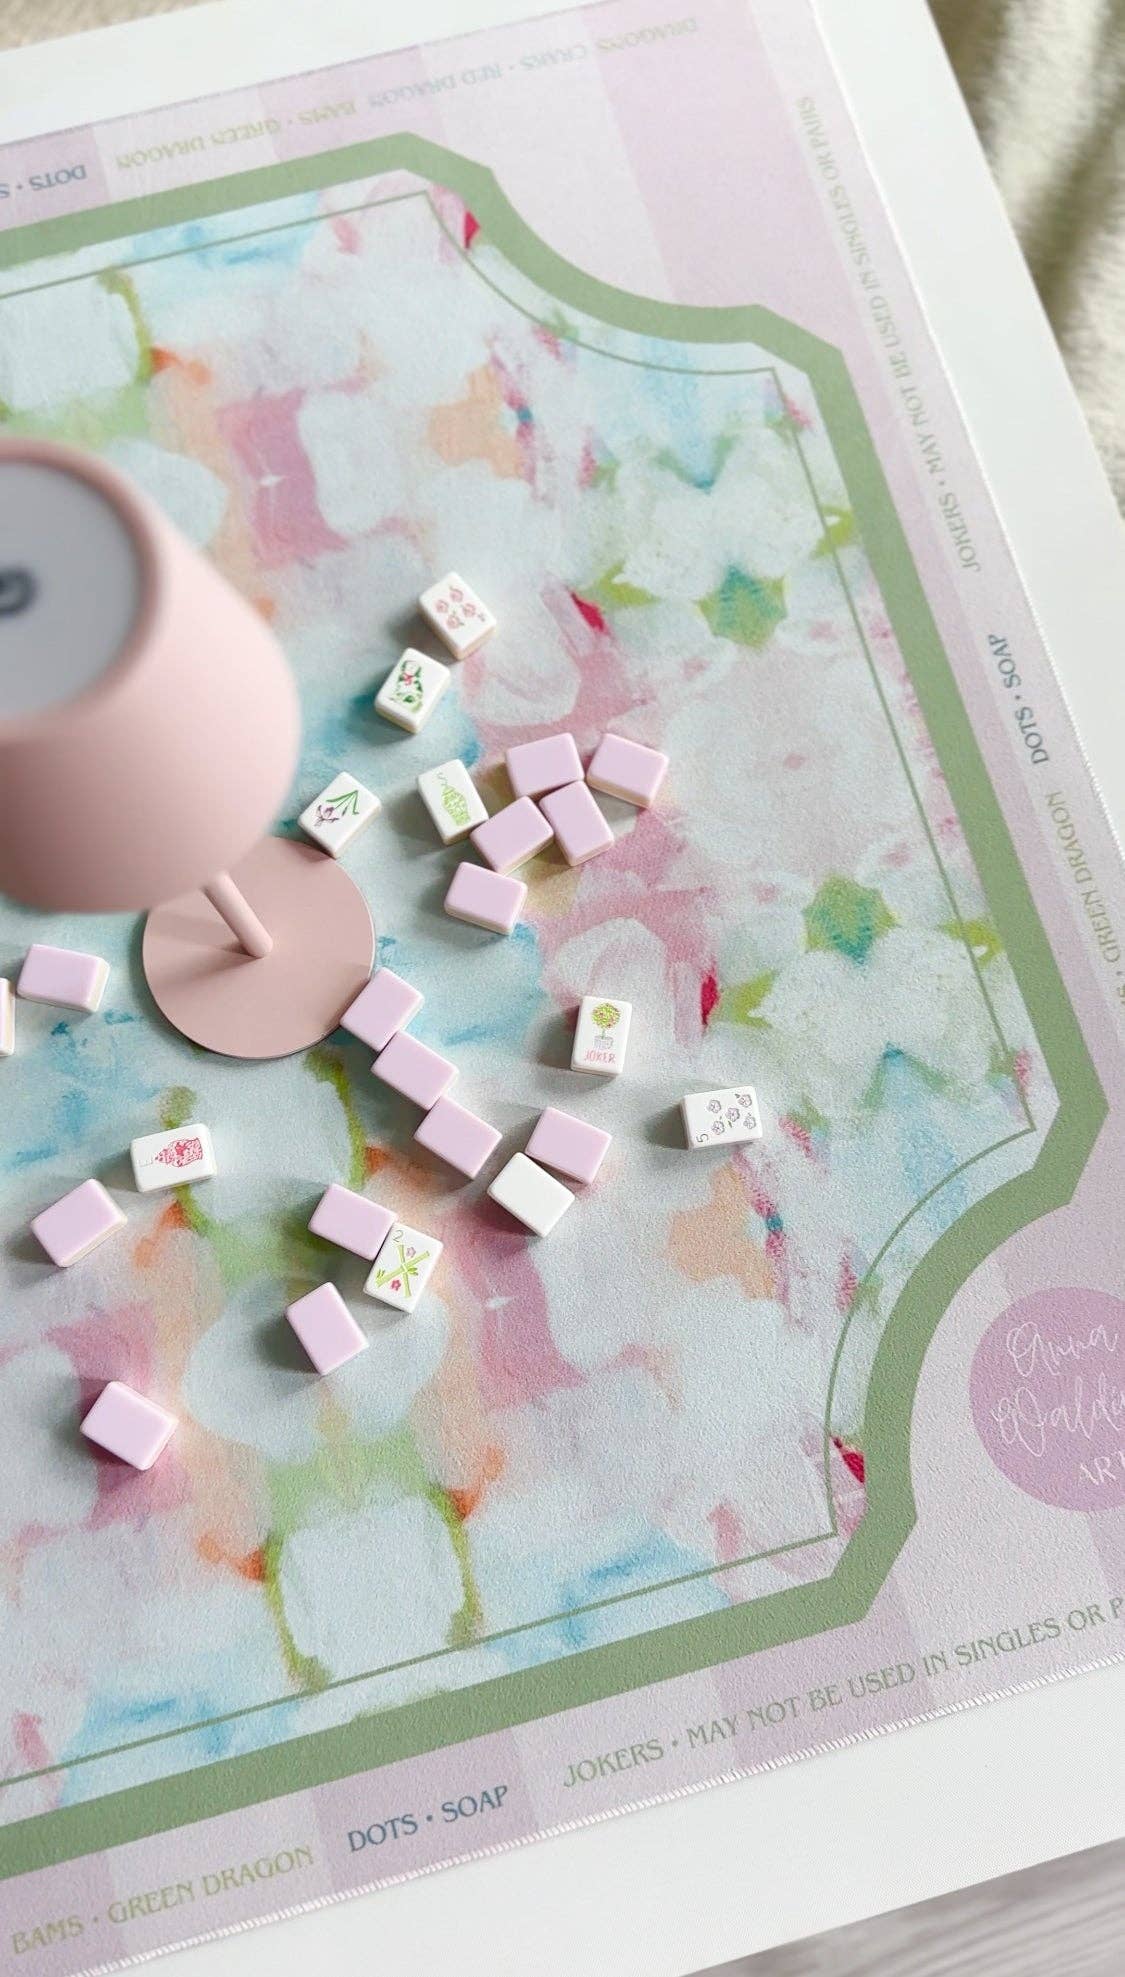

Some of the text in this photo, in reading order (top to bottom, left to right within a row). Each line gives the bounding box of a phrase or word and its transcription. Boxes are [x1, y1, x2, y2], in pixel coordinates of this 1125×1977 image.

[368, 75, 457, 107] DRAGON
[461, 64, 503, 87] RED
[116, 101, 357, 169] BAMS GREEN DRAGON
[29, 165, 87, 191] DOTS
[816, 151, 840, 181] OR
[828, 184, 871, 266] SINGLES
[859, 270, 881, 291] IN
[869, 295, 899, 348] USED
[889, 351, 911, 378] BE
[900, 386, 928, 427] NOT
[916, 433, 945, 474] MAY
[938, 492, 982, 573] JOKERS
[988, 634, 1049, 764] DOTS SOAP
[1045, 790, 1121, 963] GREEN DRAGON
[584, 1050, 617, 1065] JOKER
[695, 1133, 709, 1143] 5
[393, 1229, 404, 1242] 2
[1006, 1321, 1119, 1378] Anna
[563, 1738, 665, 1788] JOKERS
[686, 1714, 741, 1749] MAY
[746, 1696, 801, 1731] NOT
[804, 1684, 843, 1712] BE
[848, 1661, 916, 1699] USED
[922, 1650, 951, 1677] IN
[954, 1616, 1062, 1667] SINGLES
[1067, 1603, 1107, 1631] OR
[346, 1784, 509, 1853] DOTS SOAP
[12, 1845, 315, 1956] BAMS GREEN DRAGON
